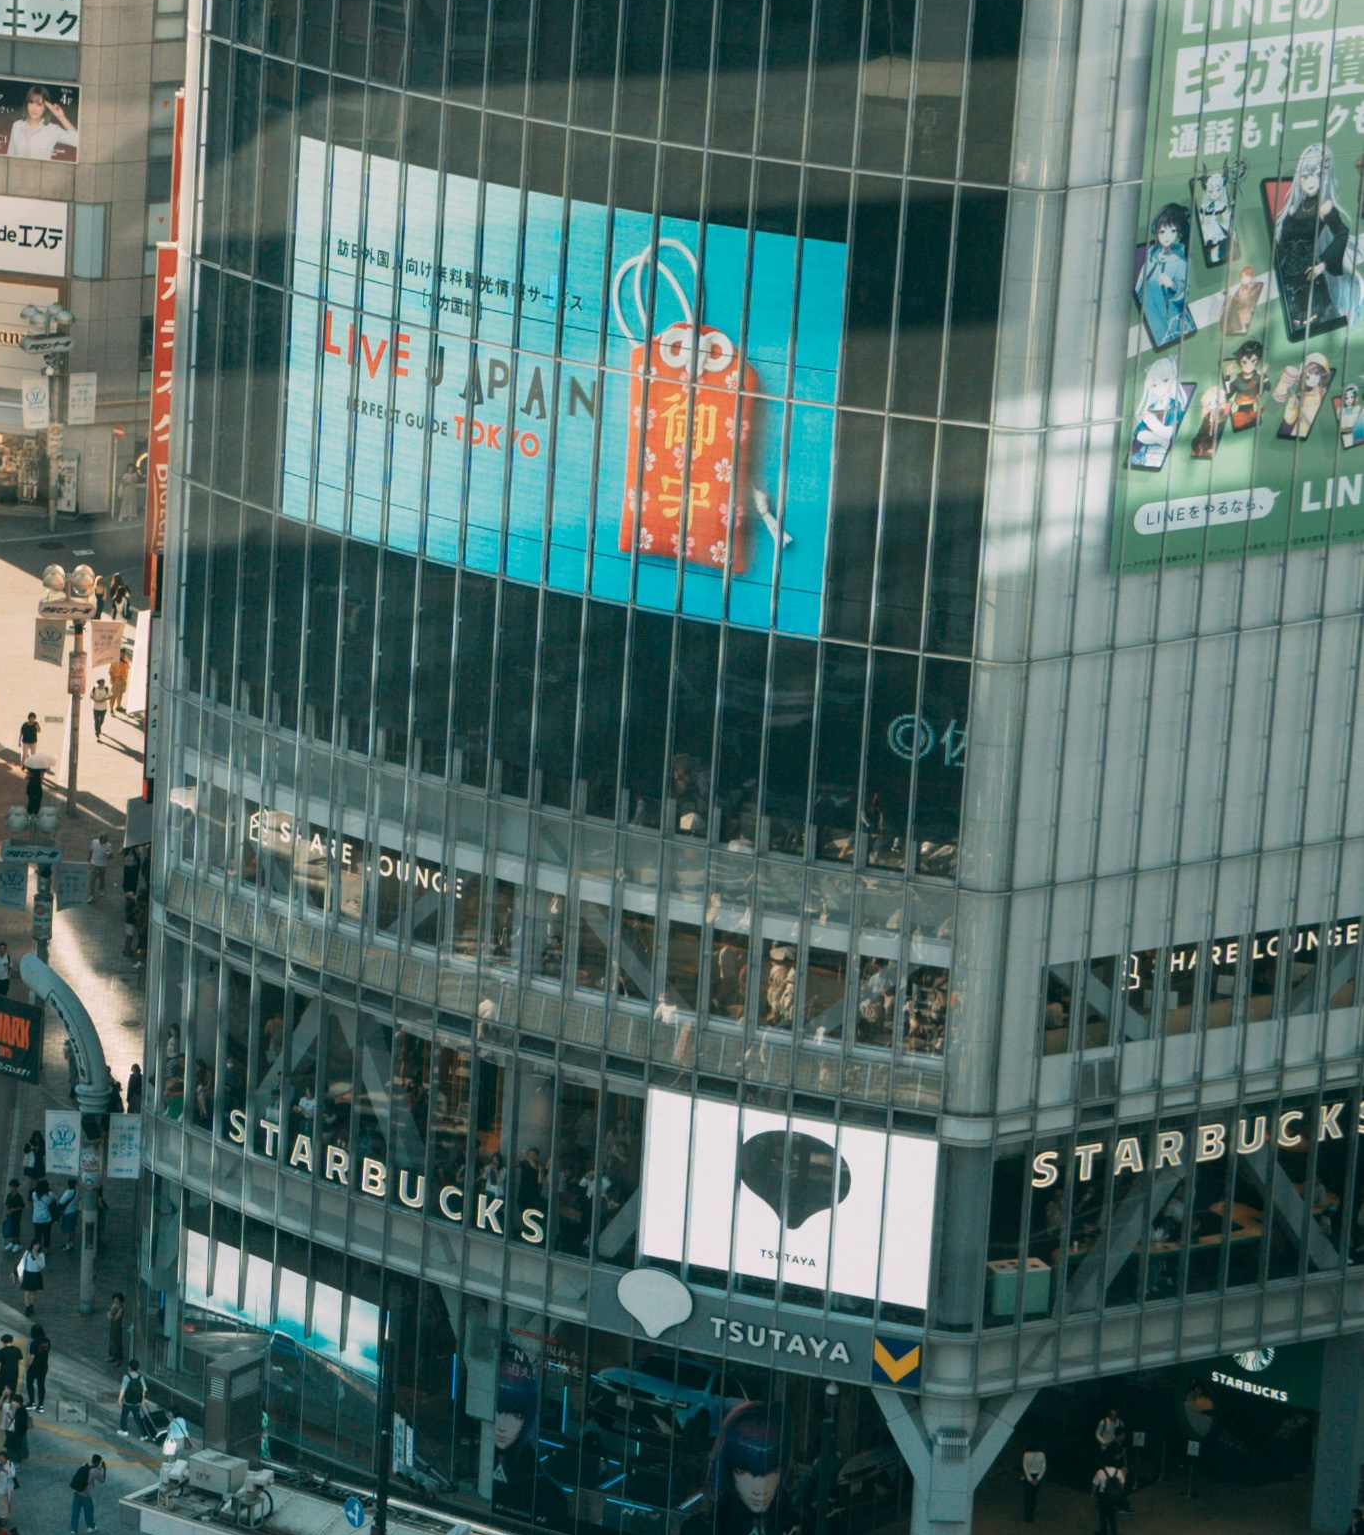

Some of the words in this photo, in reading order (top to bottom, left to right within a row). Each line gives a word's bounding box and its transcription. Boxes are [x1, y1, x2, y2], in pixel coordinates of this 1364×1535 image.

[425, 345, 597, 420] JAPAN
[229, 1108, 545, 1245] STARBUCKS
[709, 1316, 851, 1365] TSUTAYA
[1211, 1371, 1288, 1402] STARBUCKS
